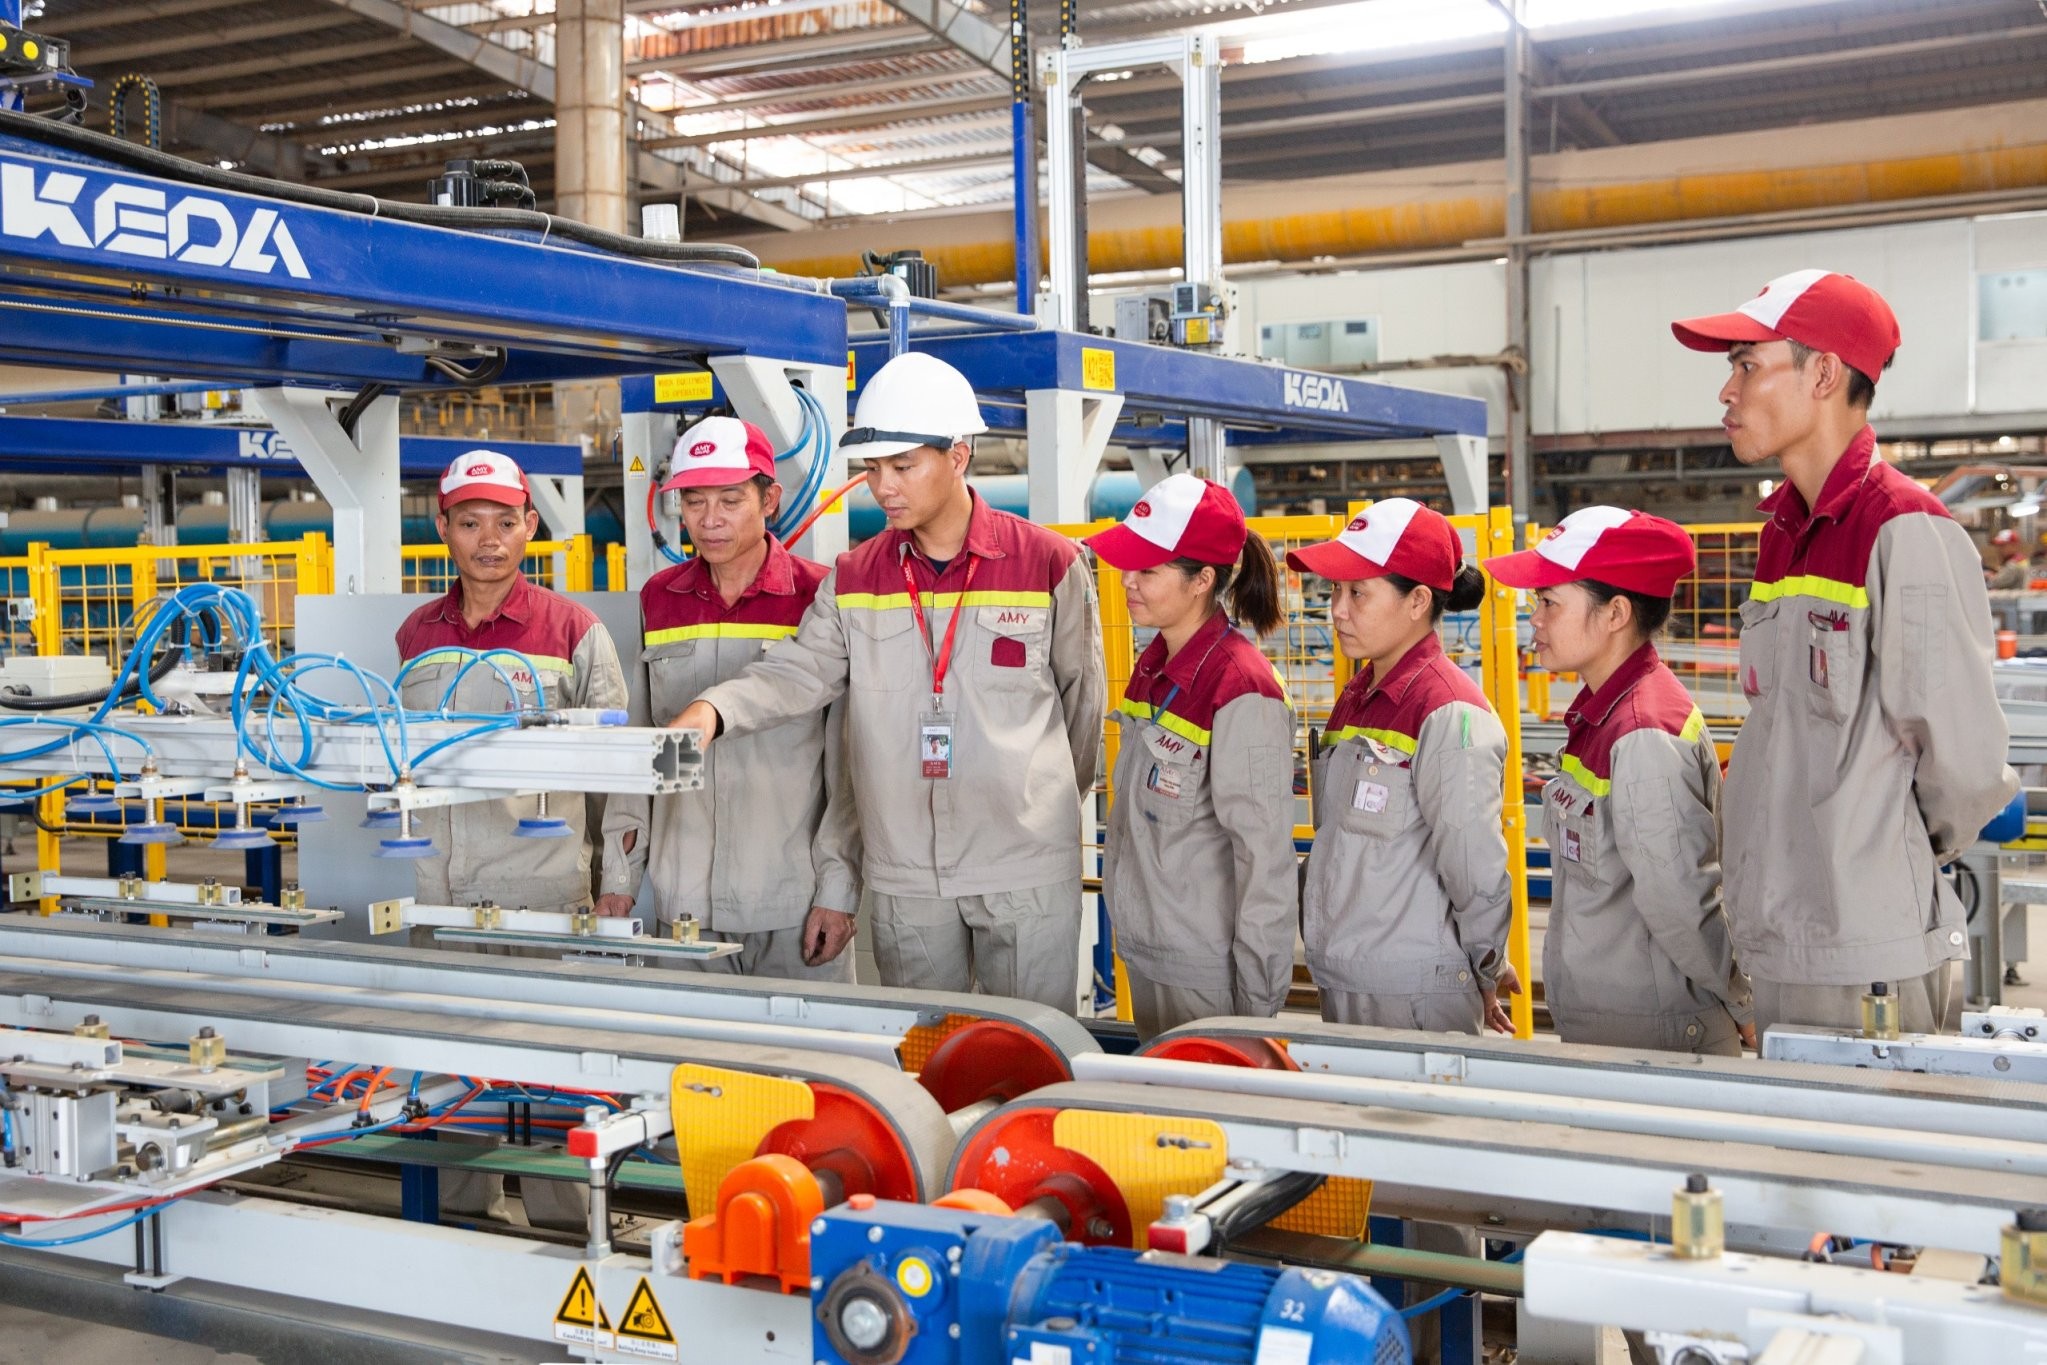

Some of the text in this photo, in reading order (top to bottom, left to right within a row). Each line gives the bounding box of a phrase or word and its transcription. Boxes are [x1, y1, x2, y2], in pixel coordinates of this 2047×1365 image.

[1, 162, 311, 279] KEDA
[1284, 372, 1349, 412] KEDA
[239, 431, 295, 459] KE
[997, 611, 1029, 624] AMY
[512, 671, 534, 684] AM
[1154, 734, 1184, 754] AMY
[1552, 787, 1577, 810] AMY
